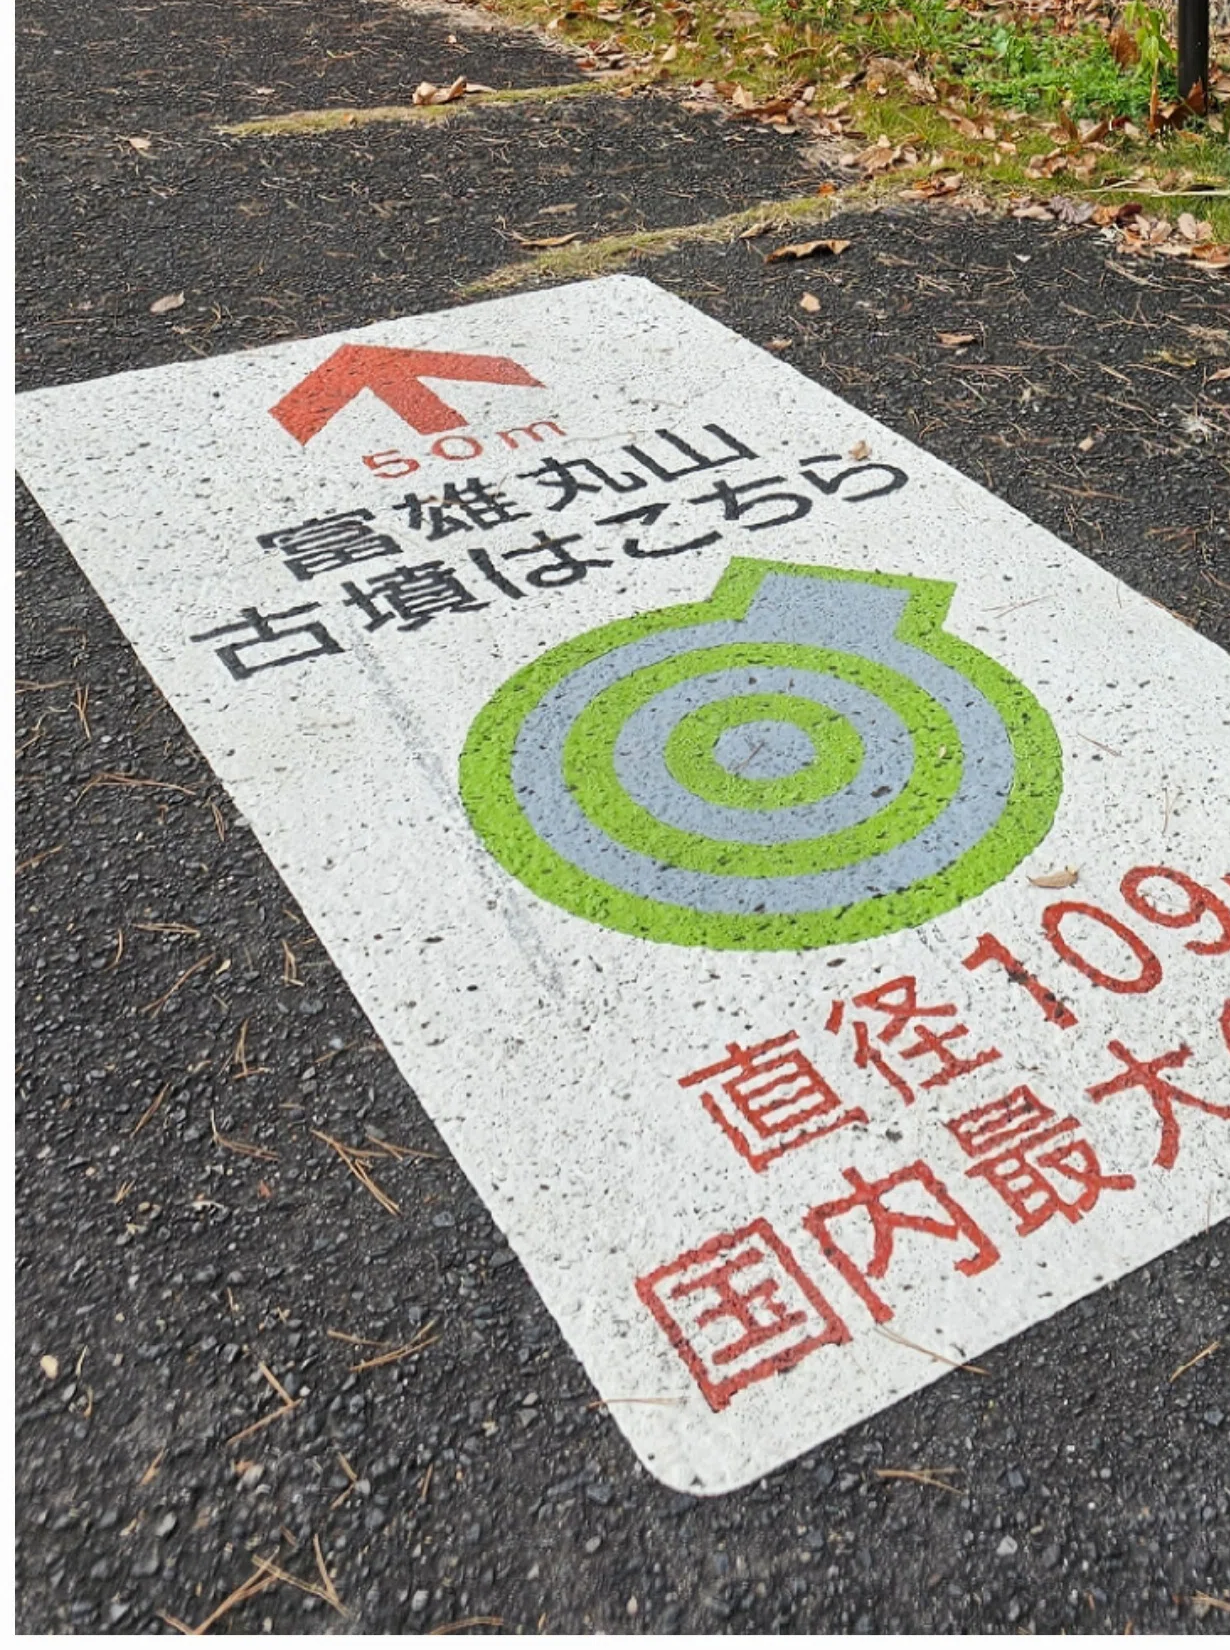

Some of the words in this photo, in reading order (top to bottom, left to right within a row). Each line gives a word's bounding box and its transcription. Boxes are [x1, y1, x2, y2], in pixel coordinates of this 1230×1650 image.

[256, 423, 760, 582] 富雄丸山
[362, 416, 567, 479] 50m
[190, 453, 909, 681] 古墳はこちら
